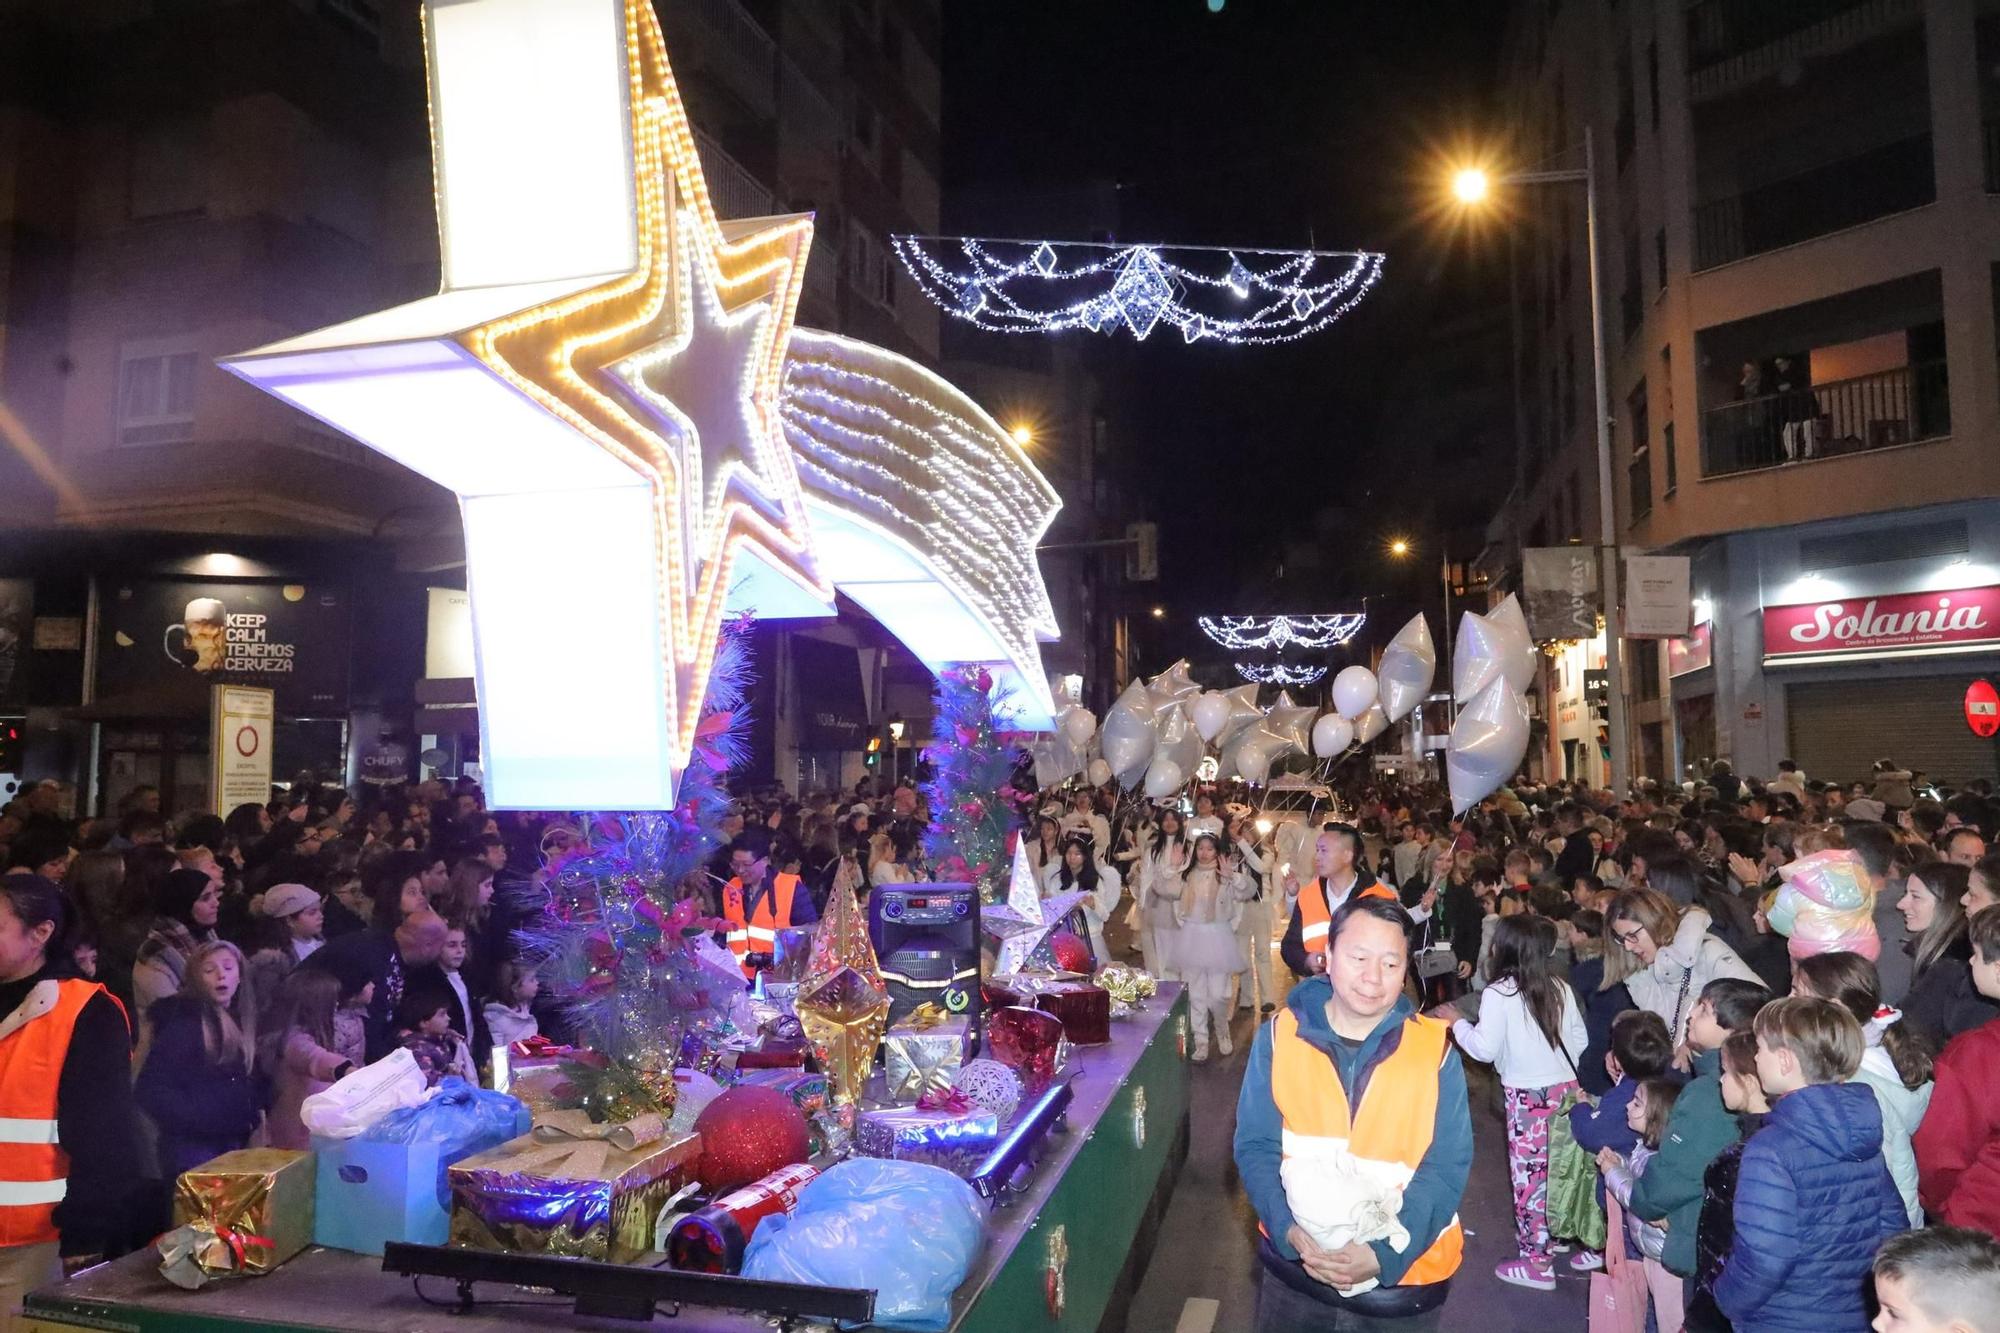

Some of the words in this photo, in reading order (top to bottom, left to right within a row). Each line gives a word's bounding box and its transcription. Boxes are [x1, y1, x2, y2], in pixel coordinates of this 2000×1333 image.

[226, 614, 267, 627] KEEP
[1790, 598, 1987, 642] Solania
[226, 629, 266, 642] CALM
[225, 643, 295, 657] TENEMOS
[224, 657, 293, 672] CERVEZA
